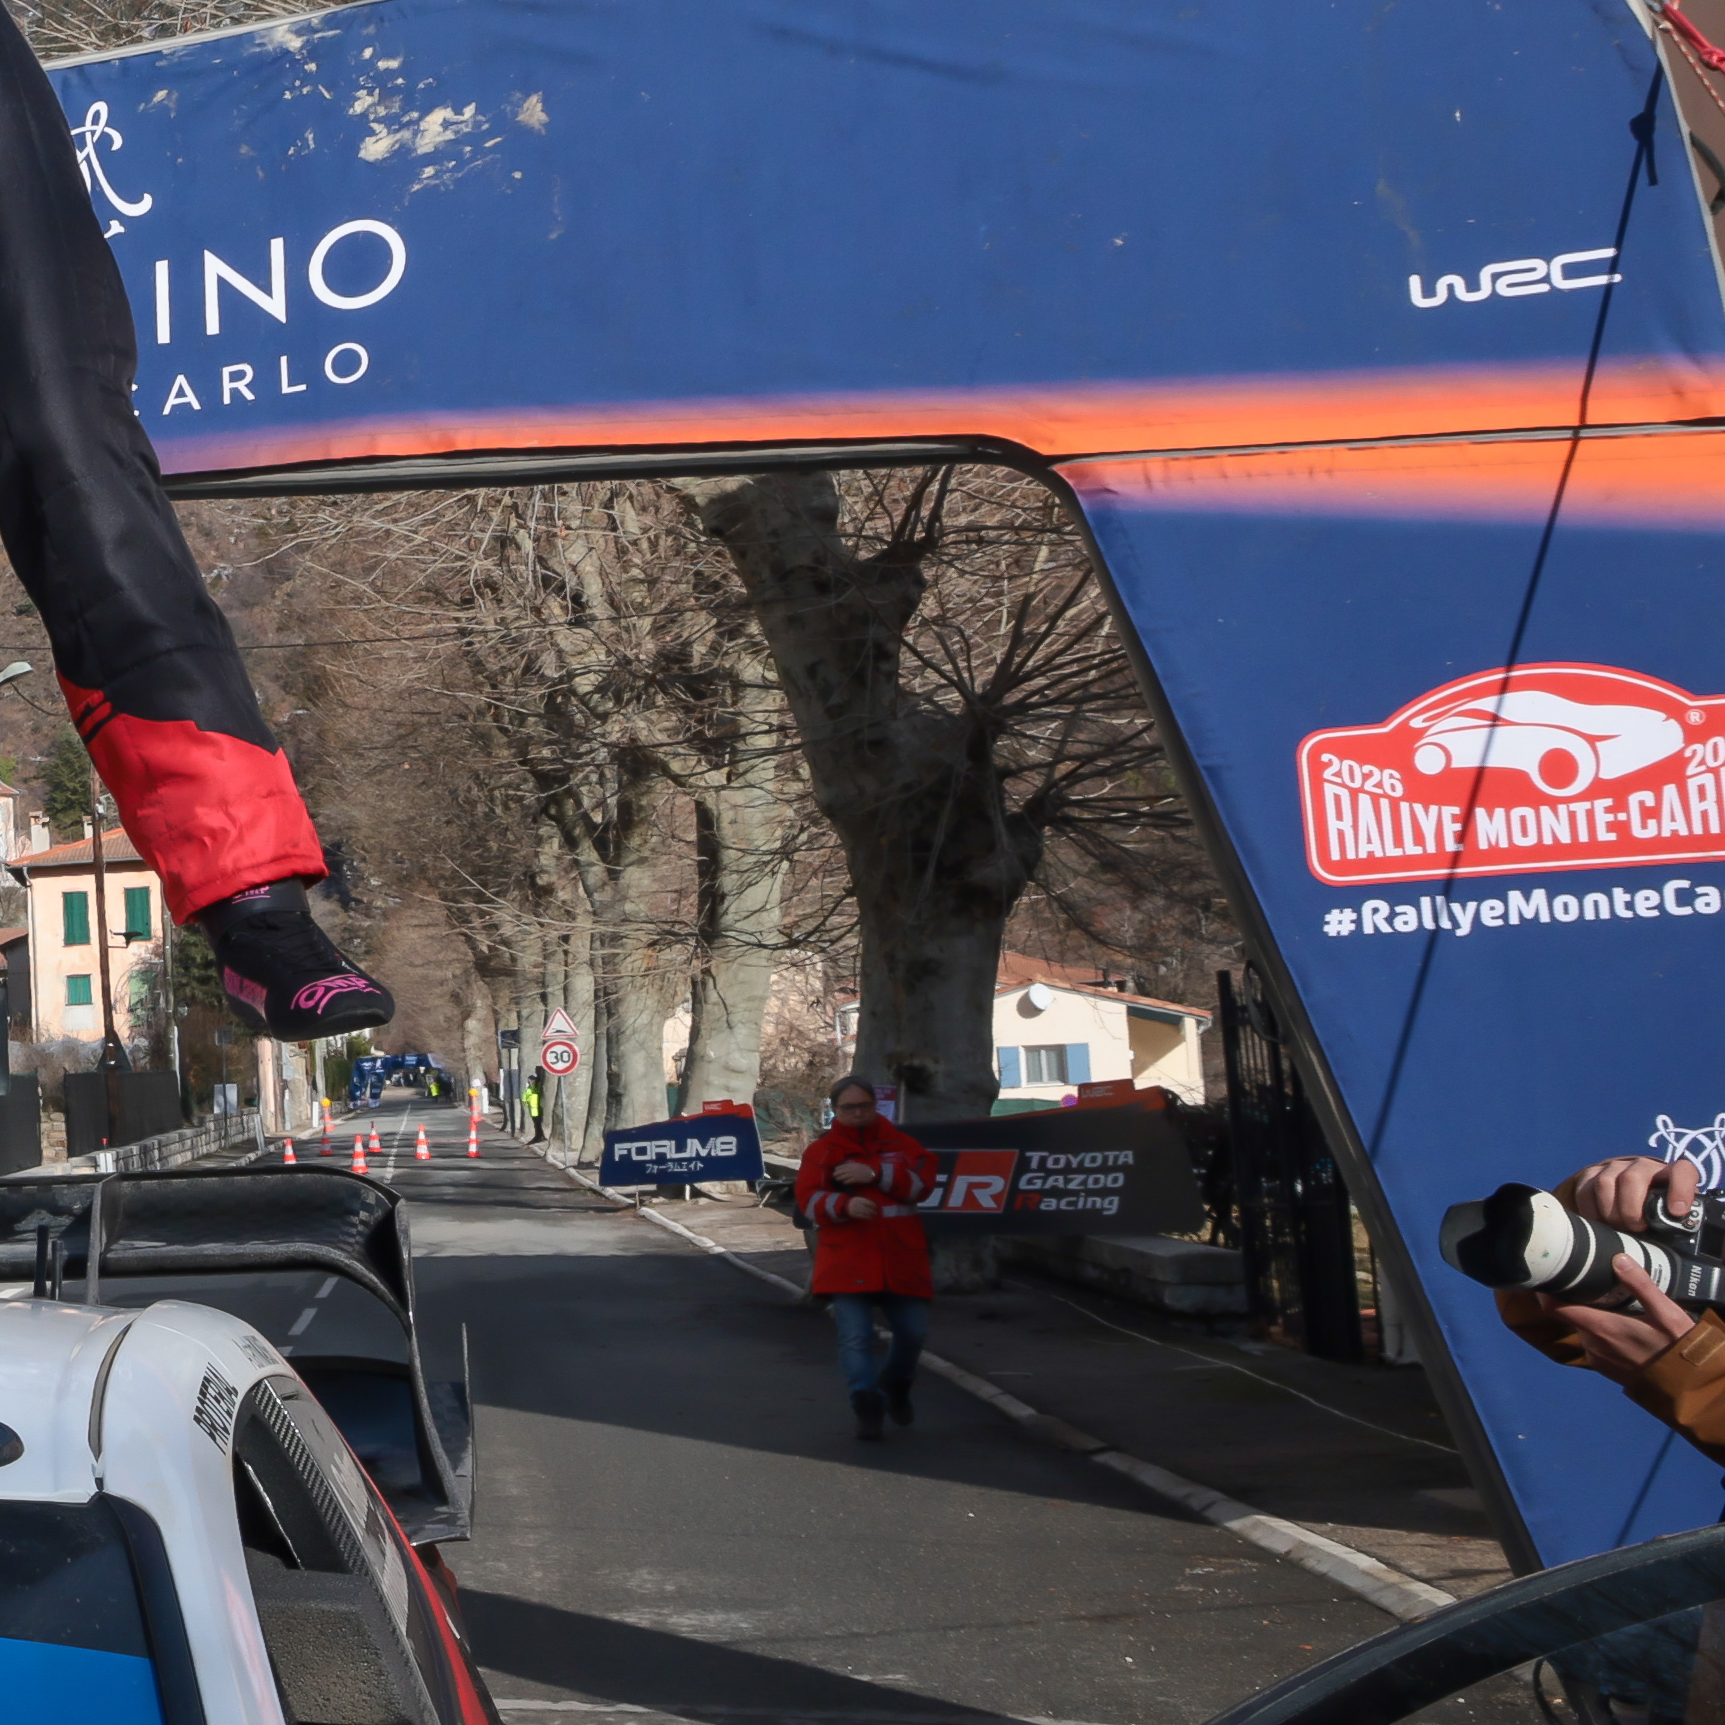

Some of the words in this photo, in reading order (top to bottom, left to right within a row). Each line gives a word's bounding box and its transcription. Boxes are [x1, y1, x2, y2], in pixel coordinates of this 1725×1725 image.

[1410, 247, 1622, 309] WRC
[1320, 752, 1404, 799] 2026
[1323, 781, 1464, 863] RALLYE
[1322, 879, 1725, 938] #RallyeMonteCa
[549, 1050, 571, 1065] 30
[614, 1136, 737, 1162] FORUM8
[1025, 1150, 1134, 1170] TOYOTA
[1018, 1172, 1125, 1190] GAZOO
[1013, 1192, 1120, 1216] Racing
[1688, 1264, 1703, 1297] Nikon
